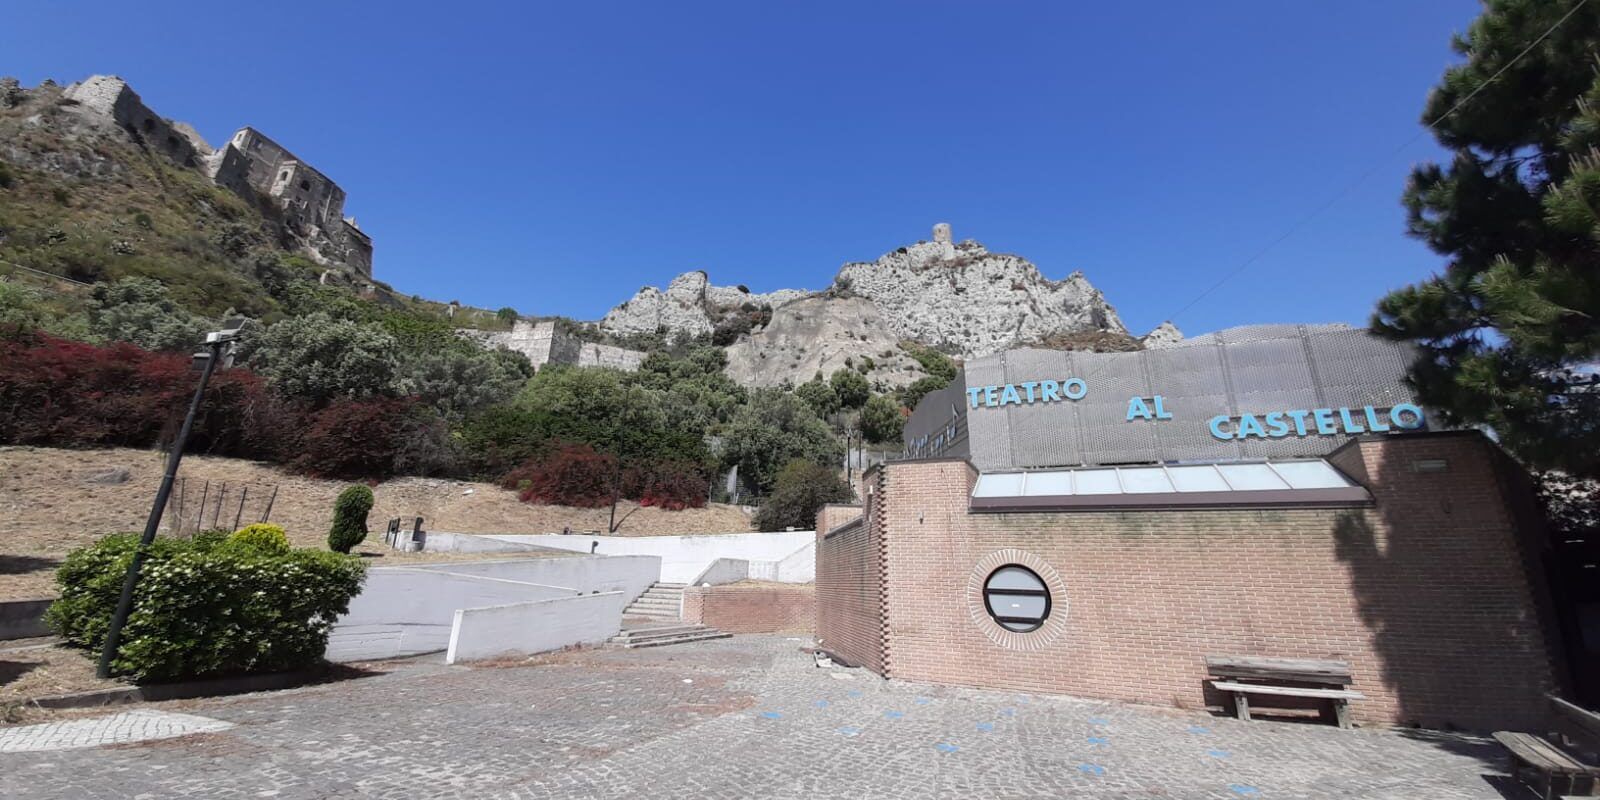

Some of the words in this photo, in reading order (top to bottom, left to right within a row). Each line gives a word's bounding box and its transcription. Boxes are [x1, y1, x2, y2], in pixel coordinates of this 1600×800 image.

[967, 377, 1087, 408] TEATRO
[1126, 397, 1172, 420] AL
[1210, 404, 1424, 440] CASTELLO
